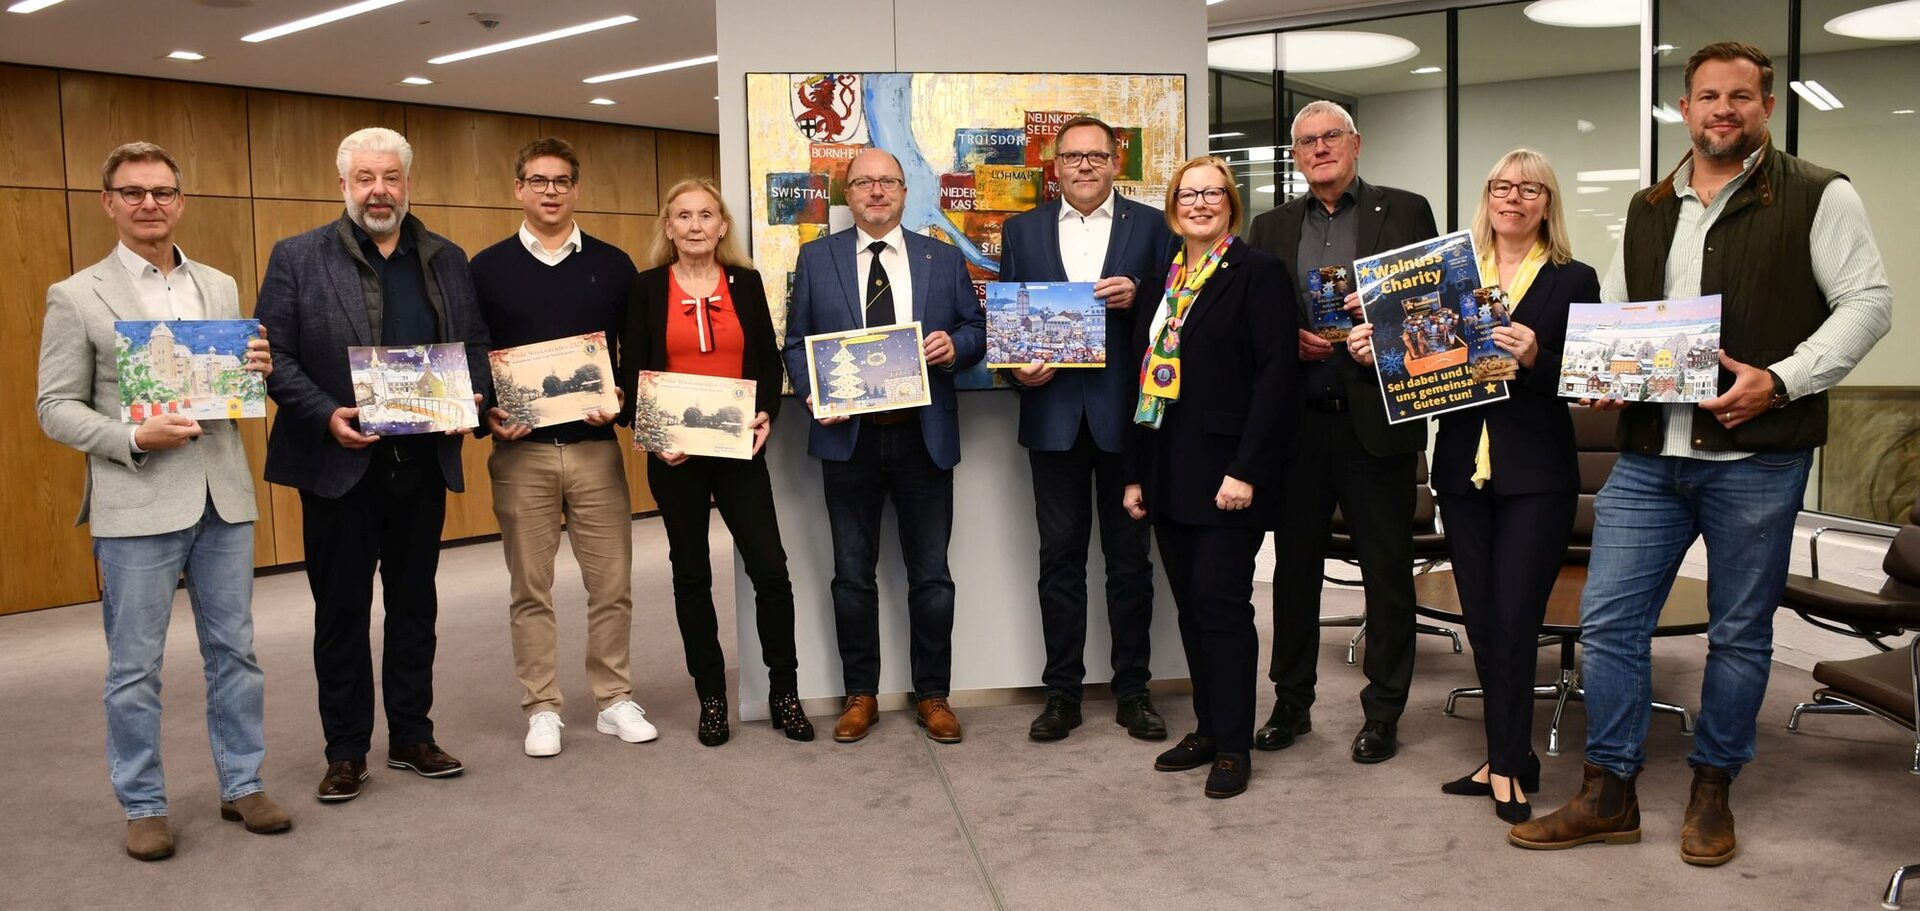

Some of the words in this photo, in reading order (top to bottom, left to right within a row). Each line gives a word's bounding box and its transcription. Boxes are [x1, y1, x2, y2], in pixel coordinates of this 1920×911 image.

[1027, 124, 1060, 136] SEELS
[957, 133, 1032, 146] TROISDORF
[811, 147, 863, 159] BORNHEI
[991, 170, 1034, 181] LOHMAR
[771, 187, 830, 200] SWISTTAL
[951, 199, 993, 210] KASSEL
[1374, 252, 1443, 279] Walnuss
[1381, 269, 1441, 294] Charity
[1387, 381, 1404, 393] Sei
[1407, 373, 1438, 389] dabei
[1440, 367, 1463, 380] und
[1396, 390, 1417, 403] uns
[1418, 378, 1480, 399] gemeinsa
[1413, 395, 1447, 410] Gutes
[1448, 389, 1472, 401] tun!
